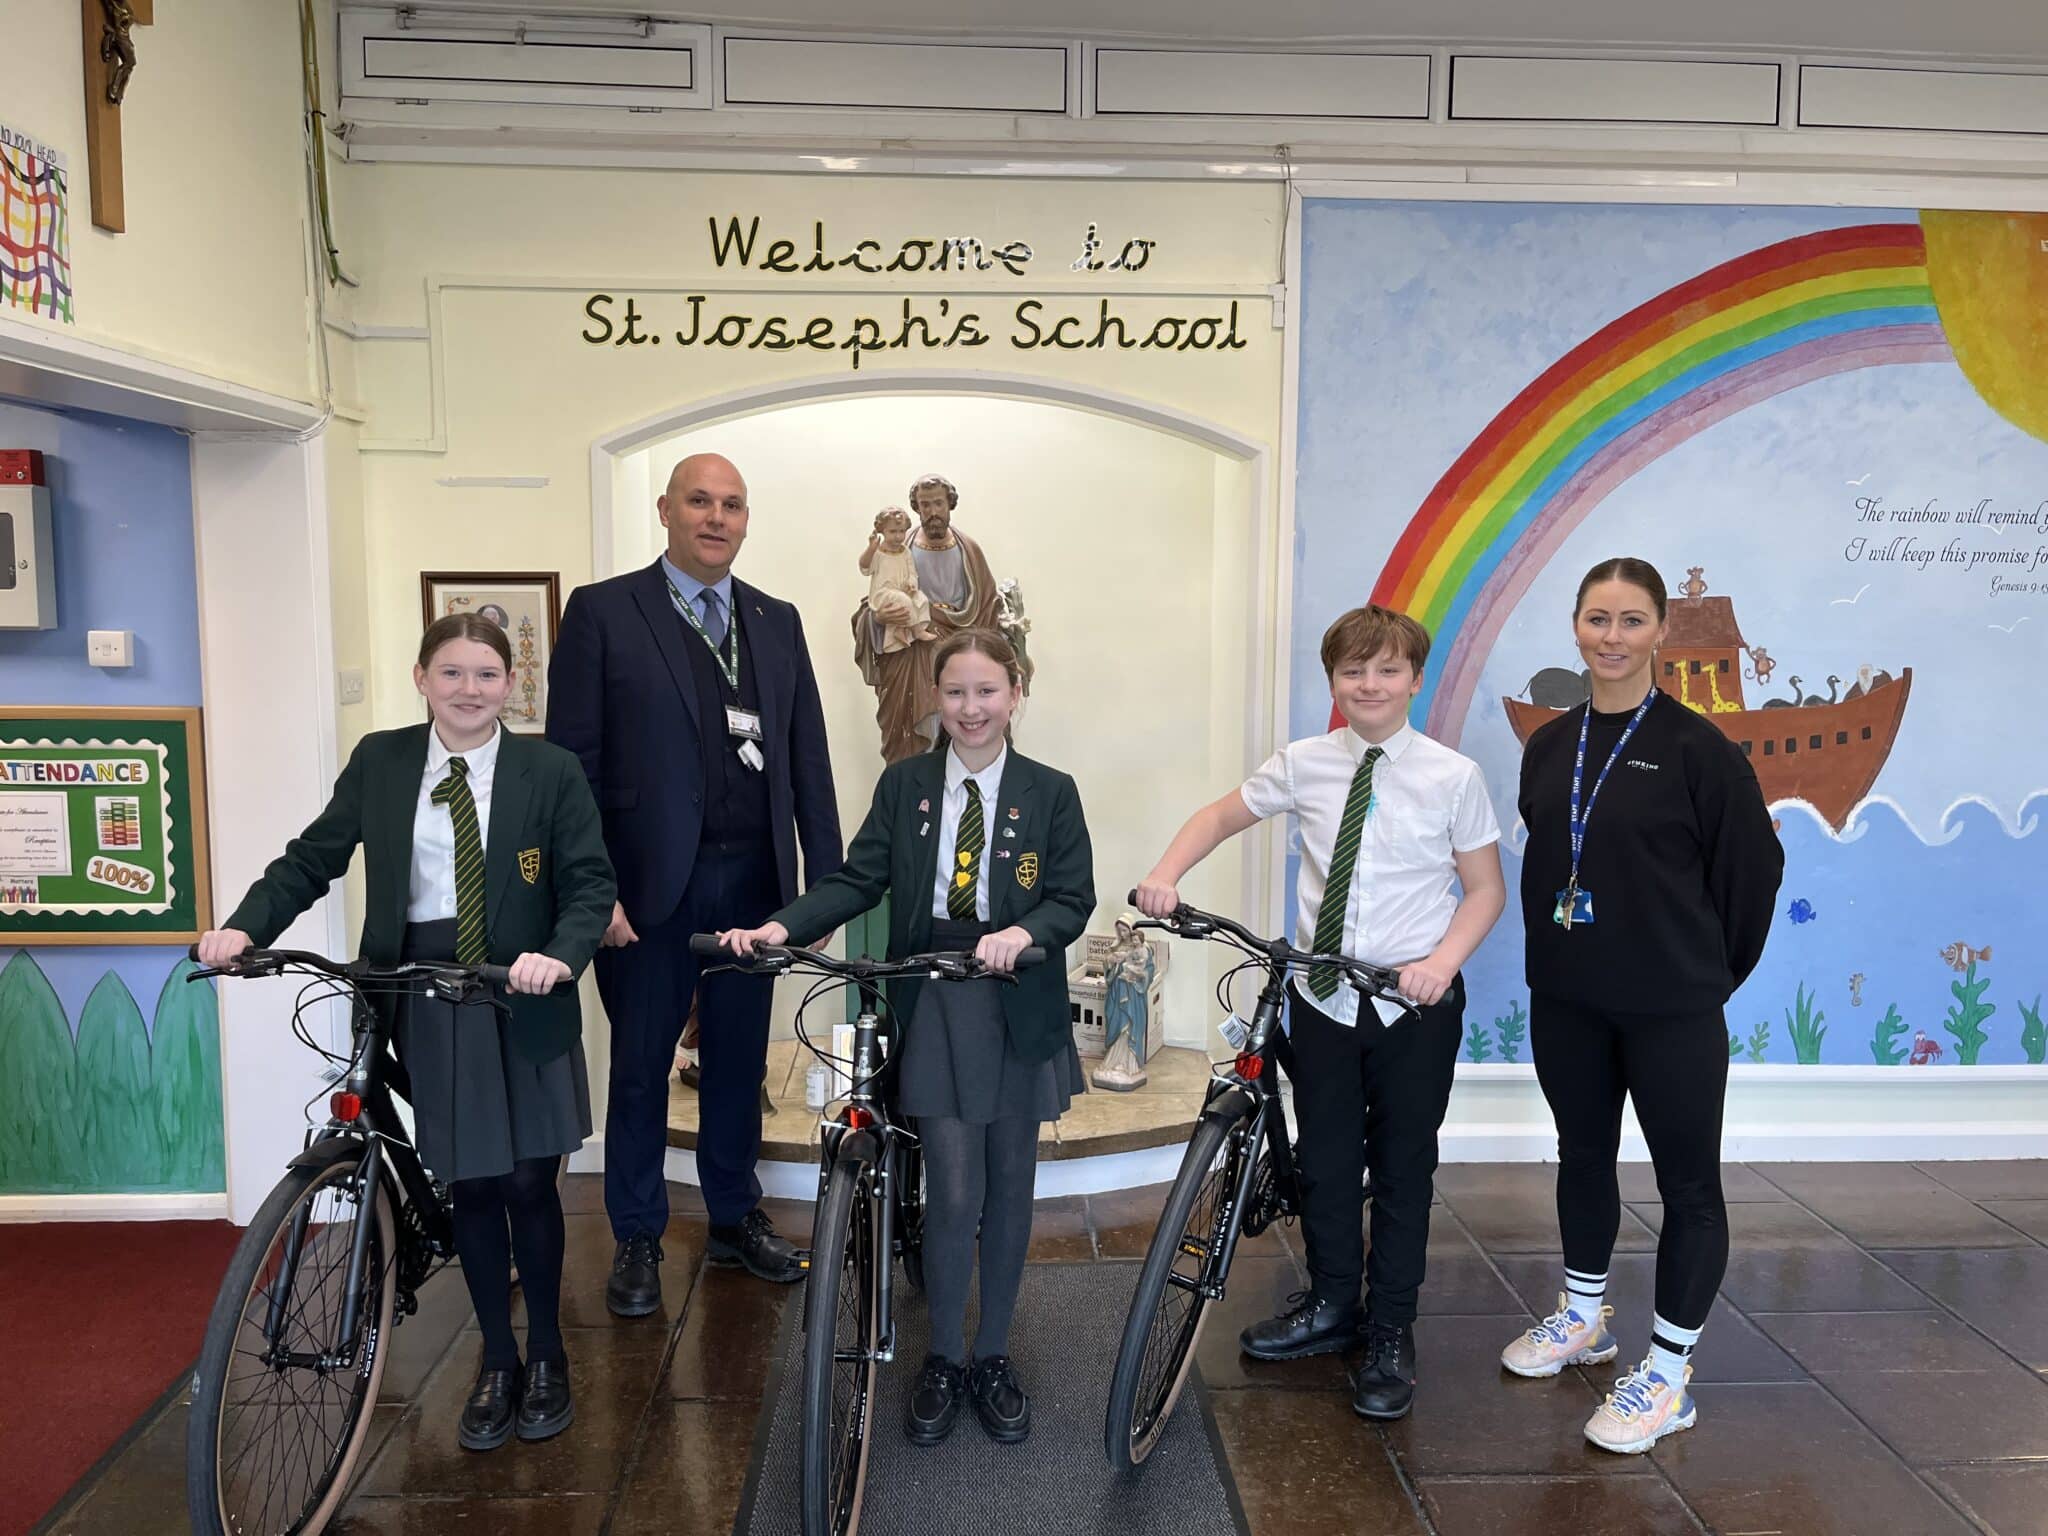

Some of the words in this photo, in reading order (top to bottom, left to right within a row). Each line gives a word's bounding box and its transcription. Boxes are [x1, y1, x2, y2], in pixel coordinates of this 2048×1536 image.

[709, 216, 1033, 276] Welcome
[1070, 222, 1156, 272] to
[582, 294, 661, 346] St.
[675, 295, 990, 370] Joseph's
[1011, 299, 1247, 350] School
[1855, 497, 1885, 522] The
[1889, 498, 1951, 524] rainbow
[1954, 498, 1993, 524] will
[1987, 500, 2048, 525] remind
[1844, 537, 1868, 562] I
[1868, 537, 1907, 562] will
[1900, 537, 1935, 571] keep
[1939, 537, 1967, 562] this
[1963, 548, 2030, 573] promise
[1989, 575, 2029, 598] Genesis
[0, 762, 144, 782] ATTENDANCE
[91, 860, 150, 892] 100%
